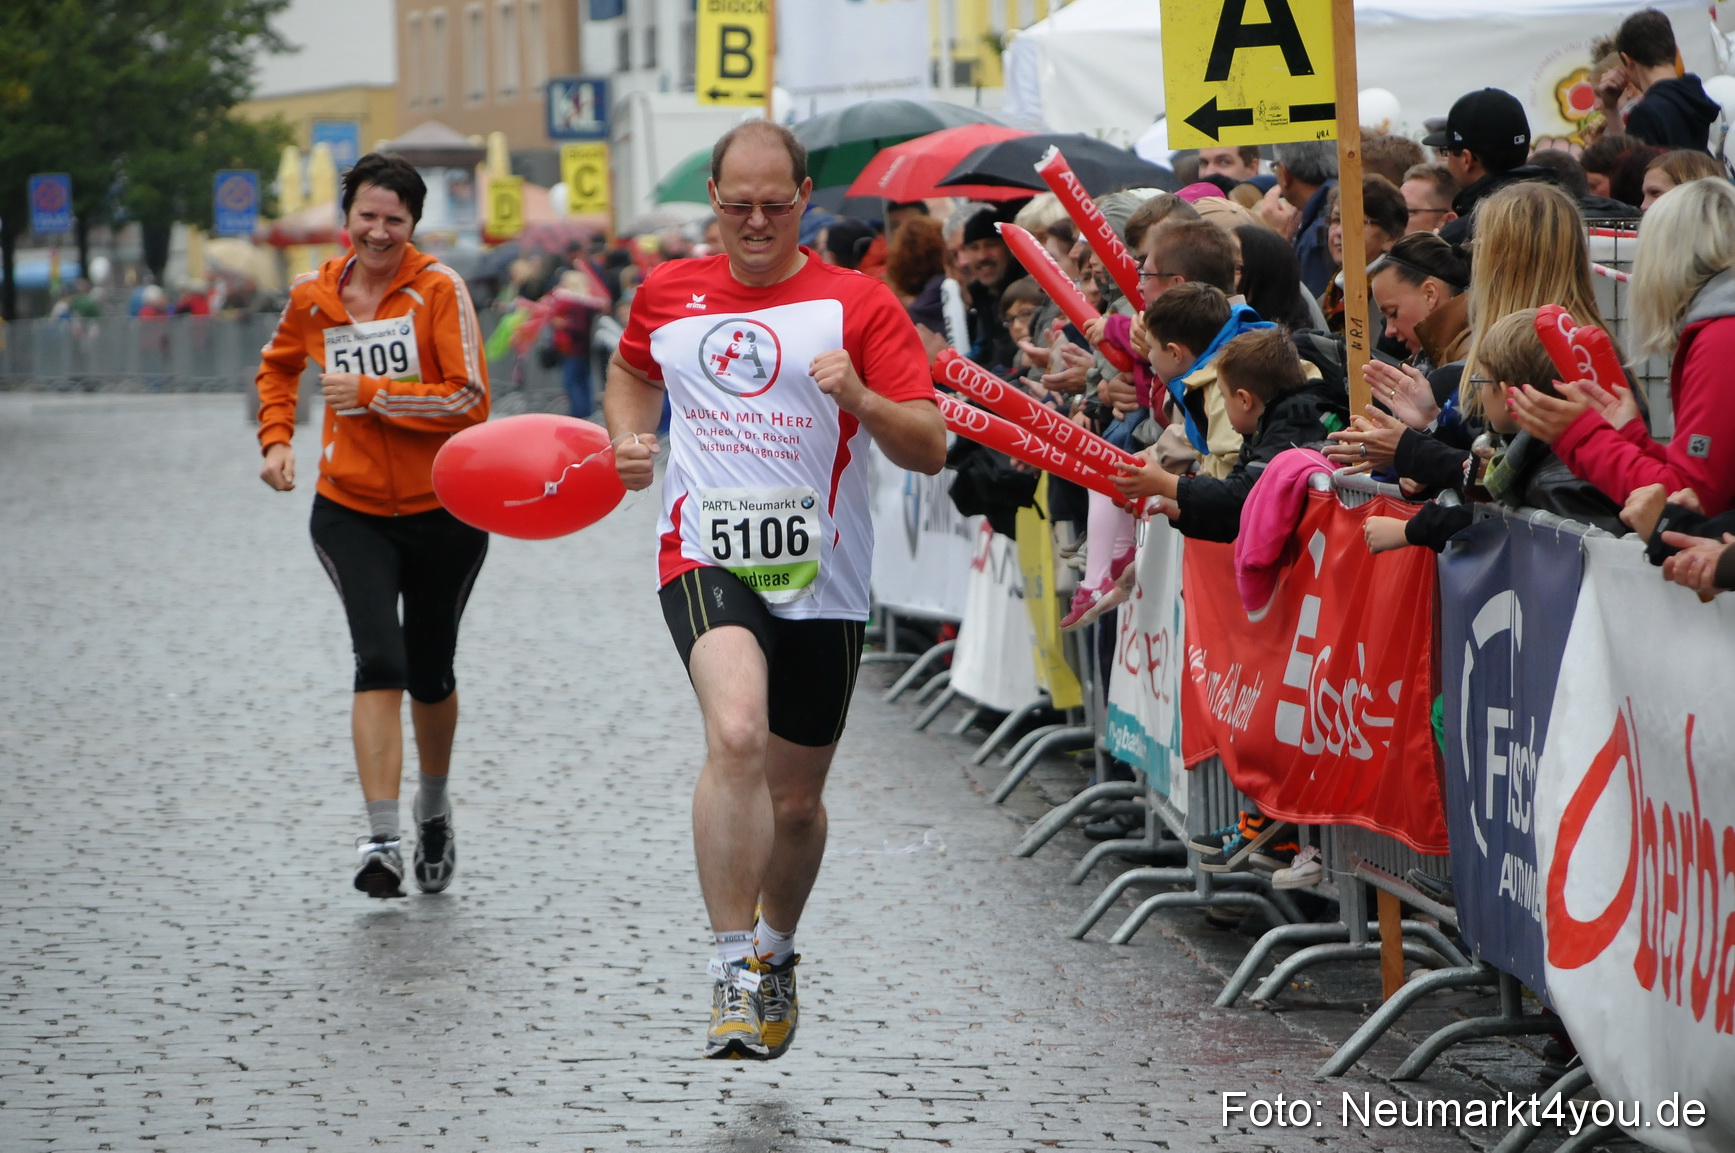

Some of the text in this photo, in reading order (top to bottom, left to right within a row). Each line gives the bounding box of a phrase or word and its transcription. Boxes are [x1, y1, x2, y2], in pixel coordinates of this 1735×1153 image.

[719, 24, 754, 79] B
[1204, 0, 1315, 82] A
[574, 164, 599, 200] C
[494, 193, 519, 220] D
[1058, 170, 1133, 269] Audi BKK
[686, 302, 707, 310] erima
[326, 329, 396, 344] PARTL Neumarkt
[335, 340, 408, 375] 5109
[736, 412, 763, 424] MIT
[771, 412, 813, 429] HERZ
[1020, 402, 1073, 444] BKK
[763, 432, 800, 444] Röschl
[702, 499, 796, 511] PARTL Neumarkt
[712, 515, 809, 560] 5106
[731, 571, 790, 588] ndreas
